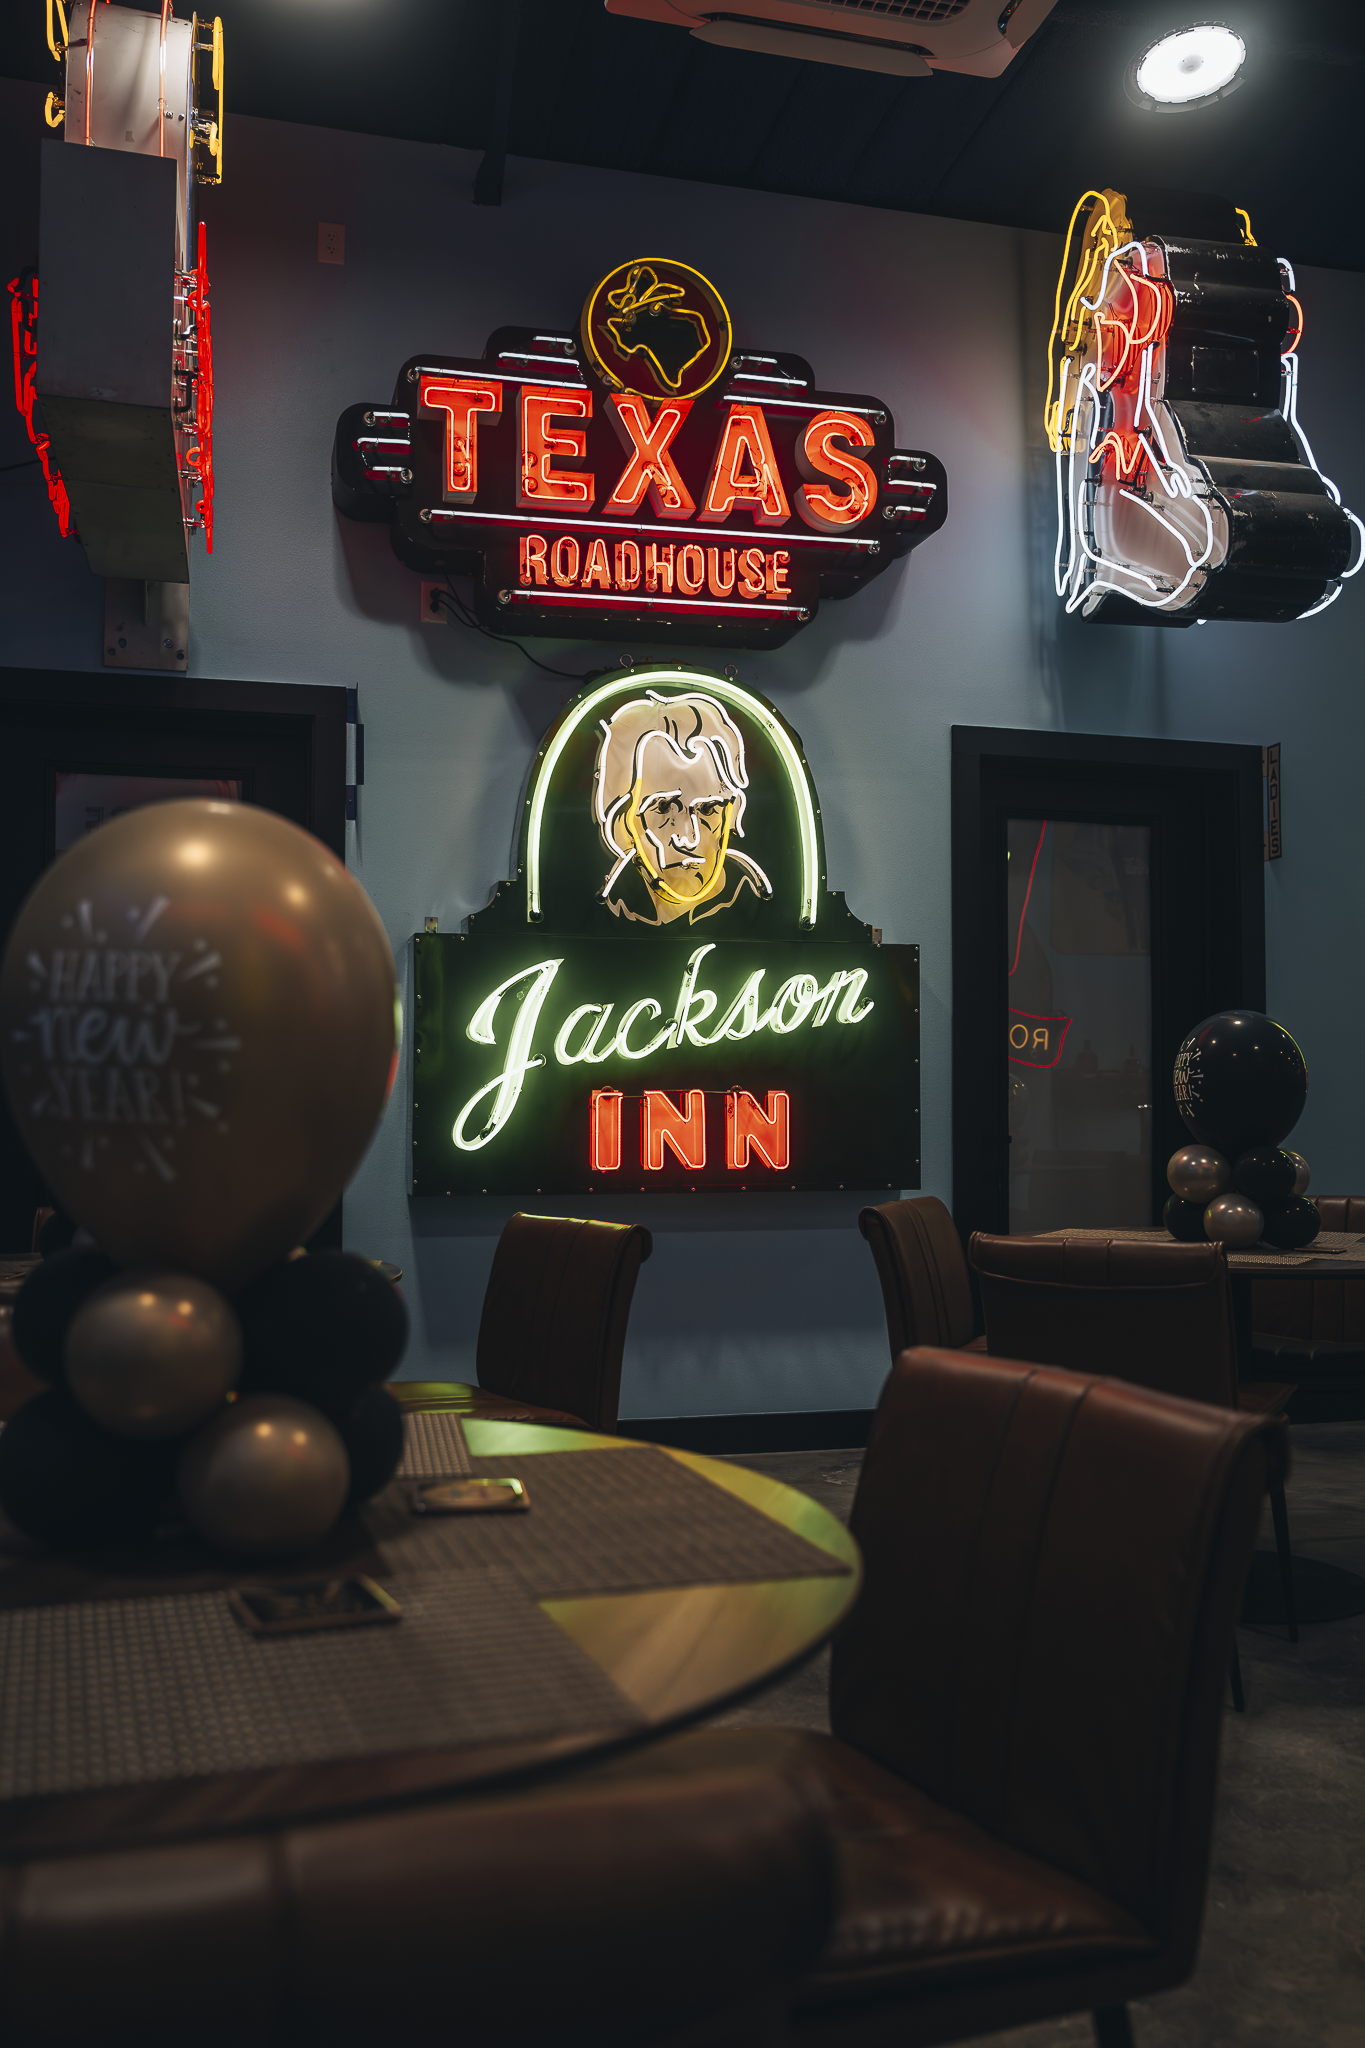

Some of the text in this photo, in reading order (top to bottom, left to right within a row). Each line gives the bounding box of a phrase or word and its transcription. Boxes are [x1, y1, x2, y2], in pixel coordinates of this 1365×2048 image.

[418, 375, 878, 532] TEXAS
[518, 534, 791, 600] ROADHOUSE
[1269, 750, 1279, 854] LADIES
[48, 949, 182, 1001] HAPPY
[452, 943, 875, 1151] Jackson
[1174, 1052, 1194, 1069] APPY
[48, 1065, 188, 1128] YEAR!
[1174, 1084, 1194, 1102] EAR!
[589, 1088, 790, 1171] INN
